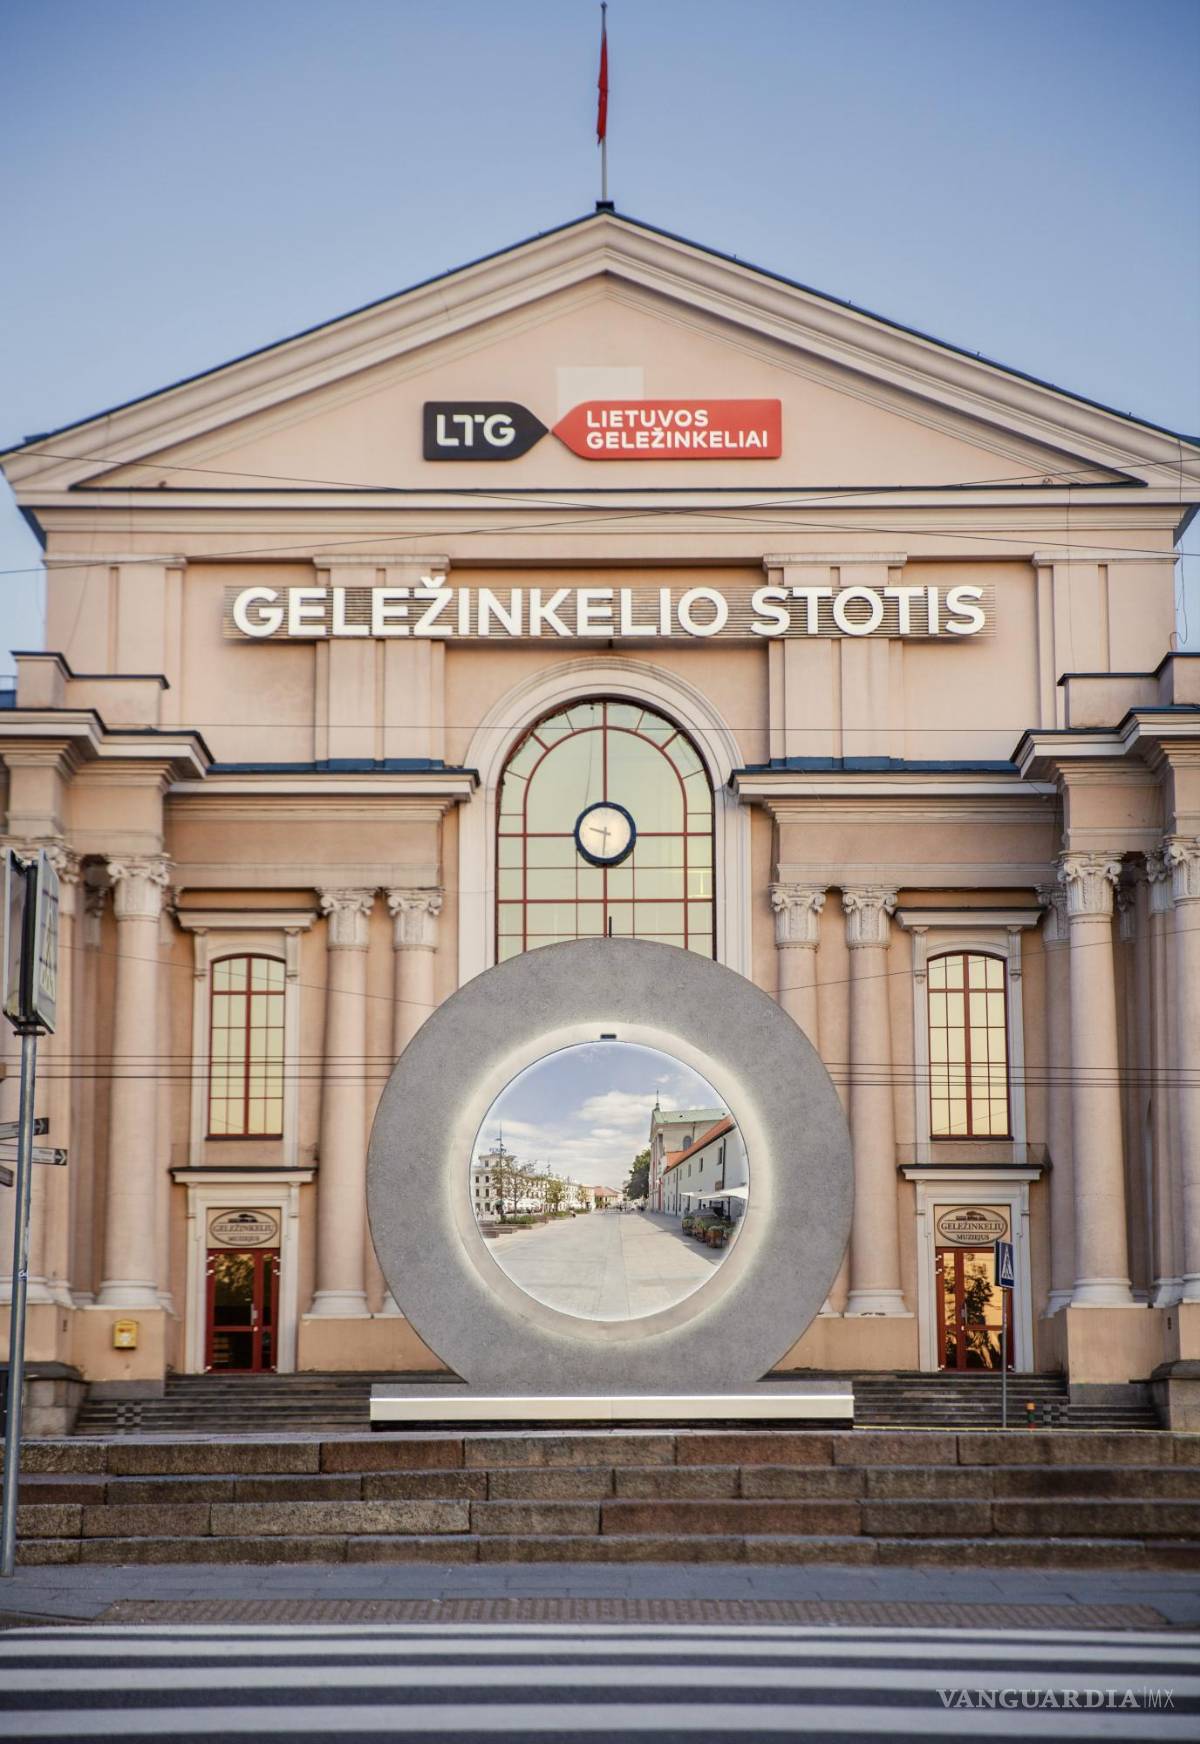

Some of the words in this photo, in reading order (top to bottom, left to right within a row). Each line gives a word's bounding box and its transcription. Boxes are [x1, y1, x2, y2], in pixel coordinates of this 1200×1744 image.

[436, 413, 516, 447] LTG
[586, 409, 709, 428] LIETUVOS
[586, 428, 768, 449] GELEŽINKELIAI
[232, 576, 729, 638] GELEŽINKELIO
[750, 585, 986, 637] STOTIS
